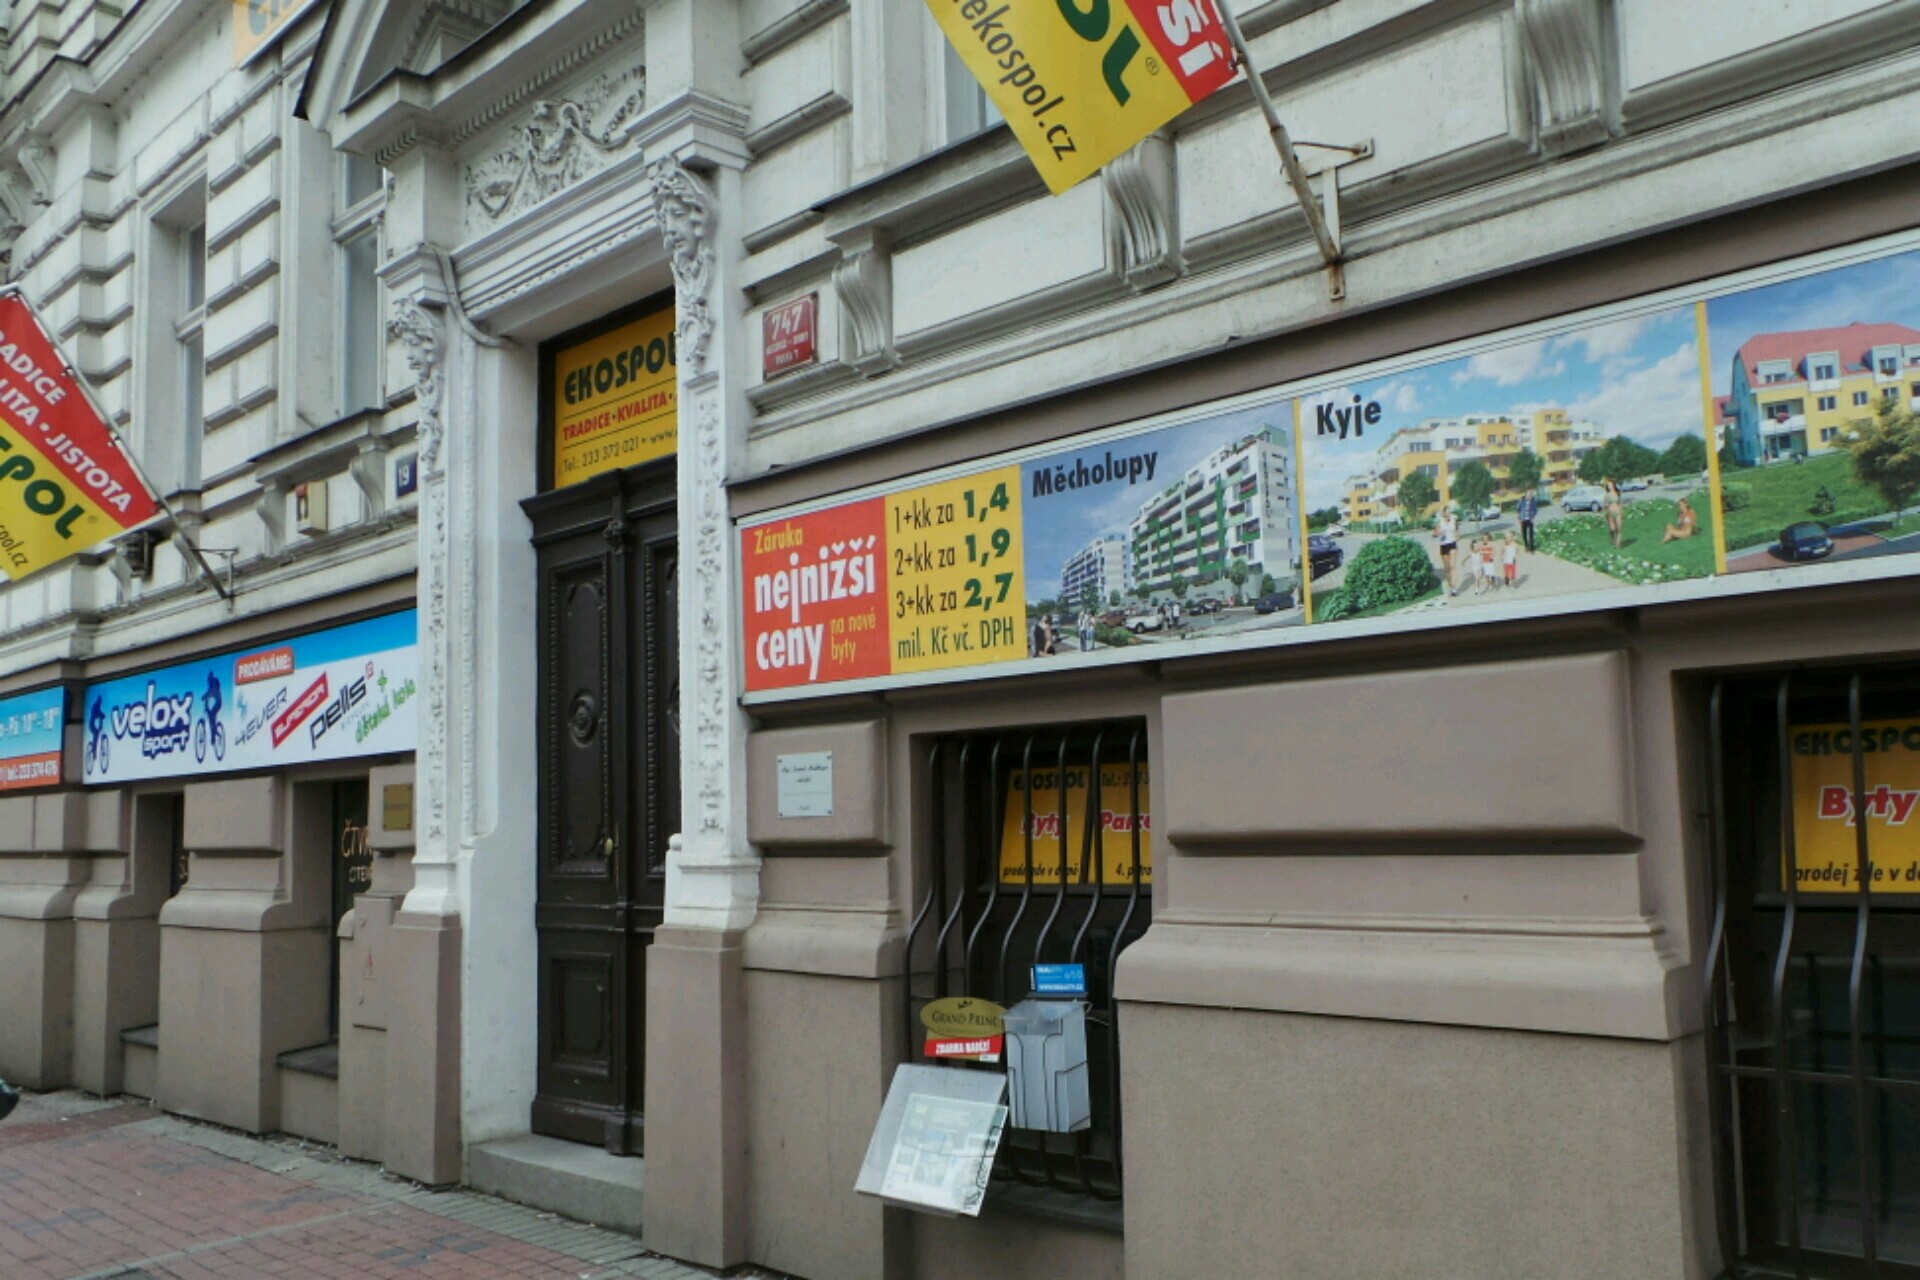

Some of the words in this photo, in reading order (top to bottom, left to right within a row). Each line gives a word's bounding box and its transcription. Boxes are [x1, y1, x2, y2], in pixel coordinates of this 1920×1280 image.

[772, 303, 803, 341] 747
[563, 412, 611, 441] TRADICE
[617, 391, 668, 423] KVALITA
[1317, 394, 1382, 440] Kyje
[45, 433, 131, 513] JISTOTA
[582, 449, 600, 467] 233
[602, 442, 620, 460] 372
[623, 436, 639, 453] 021
[399, 464, 410, 487] 19
[1032, 452, 1158, 498] Měcholupy
[894, 498, 932, 534] 1+kk
[937, 503, 954, 525] za
[963, 482, 1009, 522] 1,4
[755, 522, 803, 555] Záruka
[894, 541, 933, 576] 2+kk
[938, 547, 955, 569] za
[965, 528, 1010, 567] 1,9
[754, 535, 876, 624] nejnižší
[896, 584, 935, 619] 3+kk
[940, 590, 957, 613] za
[964, 572, 1014, 612] 2,7
[831, 617, 844, 634] na
[849, 607, 876, 632] nové
[898, 627, 925, 659] mil.
[931, 626, 949, 655] Kč
[953, 623, 974, 651] vč.
[980, 616, 1014, 649] DPH
[756, 624, 824, 681] ceny
[831, 637, 856, 665] byty
[111, 680, 193, 739] velox
[235, 687, 287, 746] 4EVER
[309, 675, 367, 749] pells
[142, 731, 189, 758] sport
[1013, 771, 1085, 790] EOSOL
[1115, 862, 1125, 876] 4.
[1127, 864, 1152, 878] ptro
[1796, 862, 1848, 887] prodej
[1890, 868, 1900, 881] v
[932, 1010, 966, 1025] GRAND
